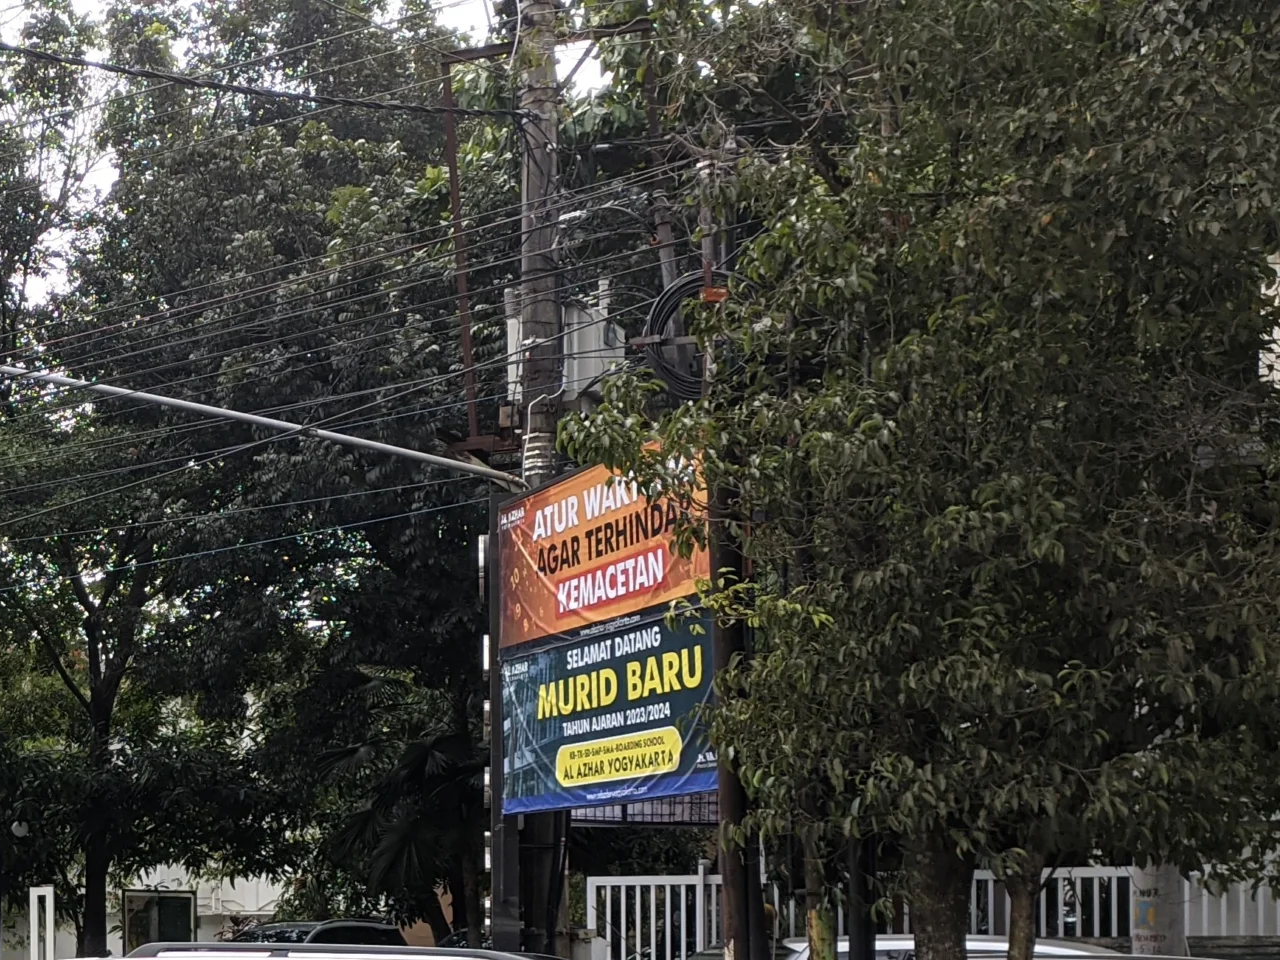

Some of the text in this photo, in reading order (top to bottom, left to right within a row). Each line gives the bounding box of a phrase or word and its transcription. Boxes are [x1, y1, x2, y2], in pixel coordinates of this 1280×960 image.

[532, 495, 579, 541] ATUR
[536, 535, 581, 578] AGAR
[557, 548, 664, 614] KEMACETAN
[566, 626, 662, 671] SELAMAT DATANG
[537, 645, 703, 721] MURID BARU
[562, 701, 671, 738] TAHUN AJARAN 2023/2024
[642, 735, 666, 749] SCHOOL
[562, 764, 575, 781] AL
[576, 760, 606, 779] AZHAR
[607, 749, 674, 774] YOGYAKARTA
